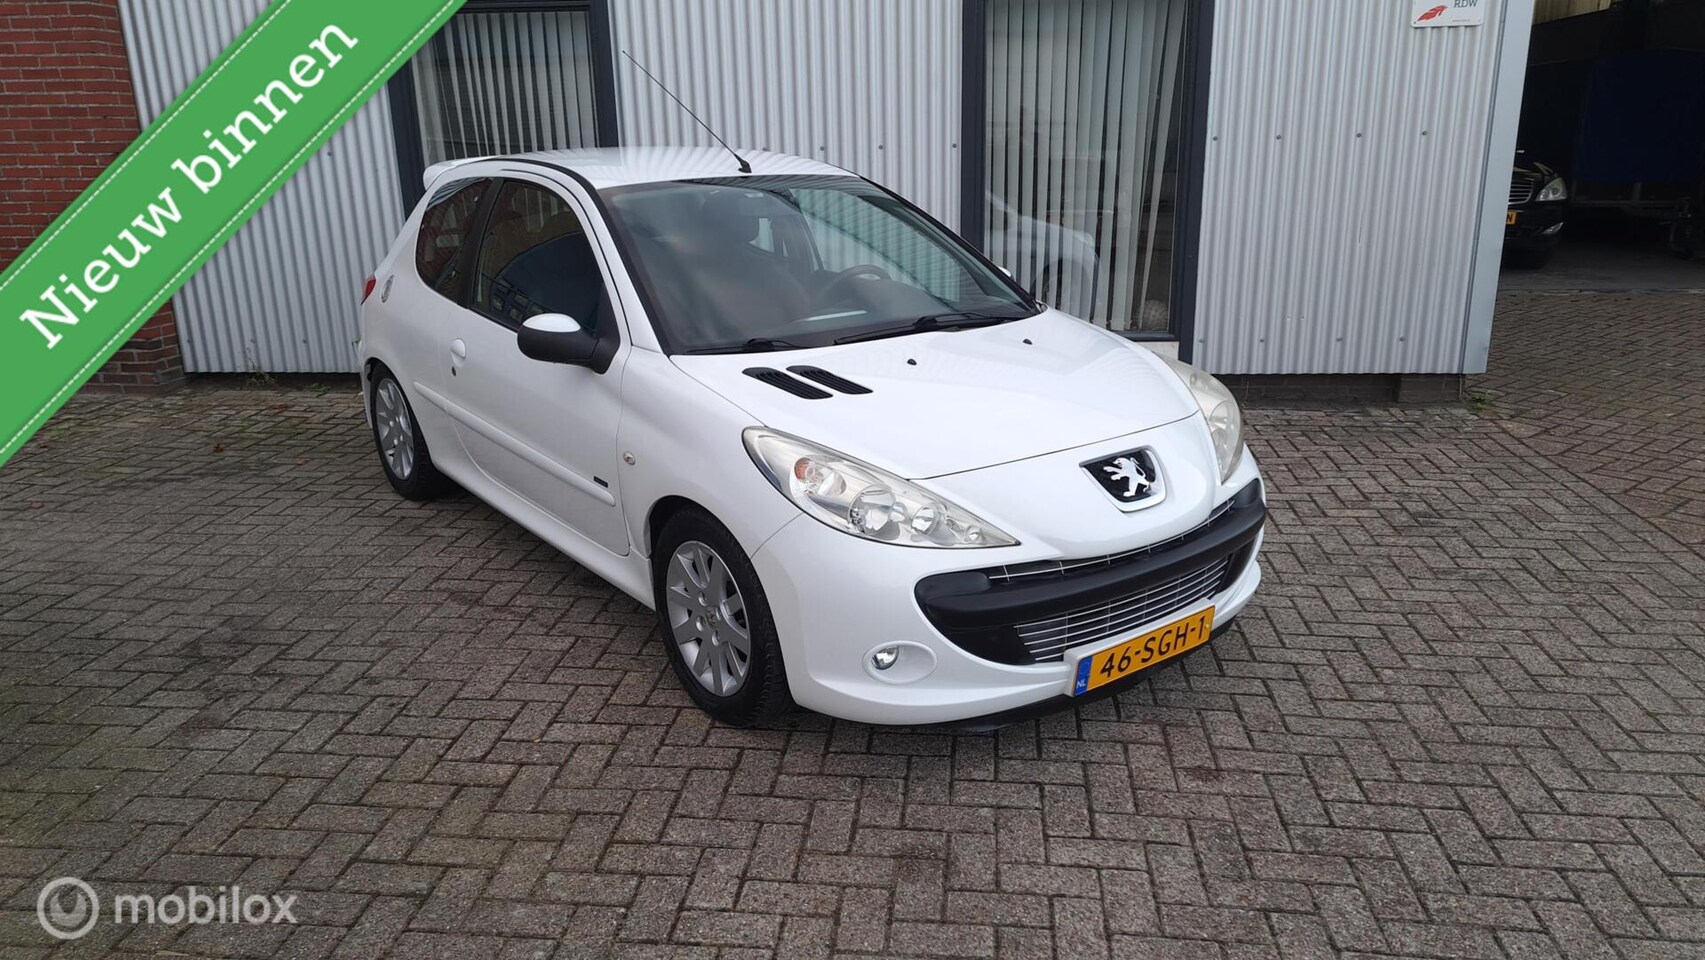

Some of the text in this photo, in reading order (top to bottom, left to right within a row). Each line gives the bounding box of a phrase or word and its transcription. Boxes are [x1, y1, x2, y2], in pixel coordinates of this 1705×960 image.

[1453, 0, 1478, 8] RDW
[1100, 615, 1206, 678] 46-SGH-1
[1076, 678, 1086, 688] NL
